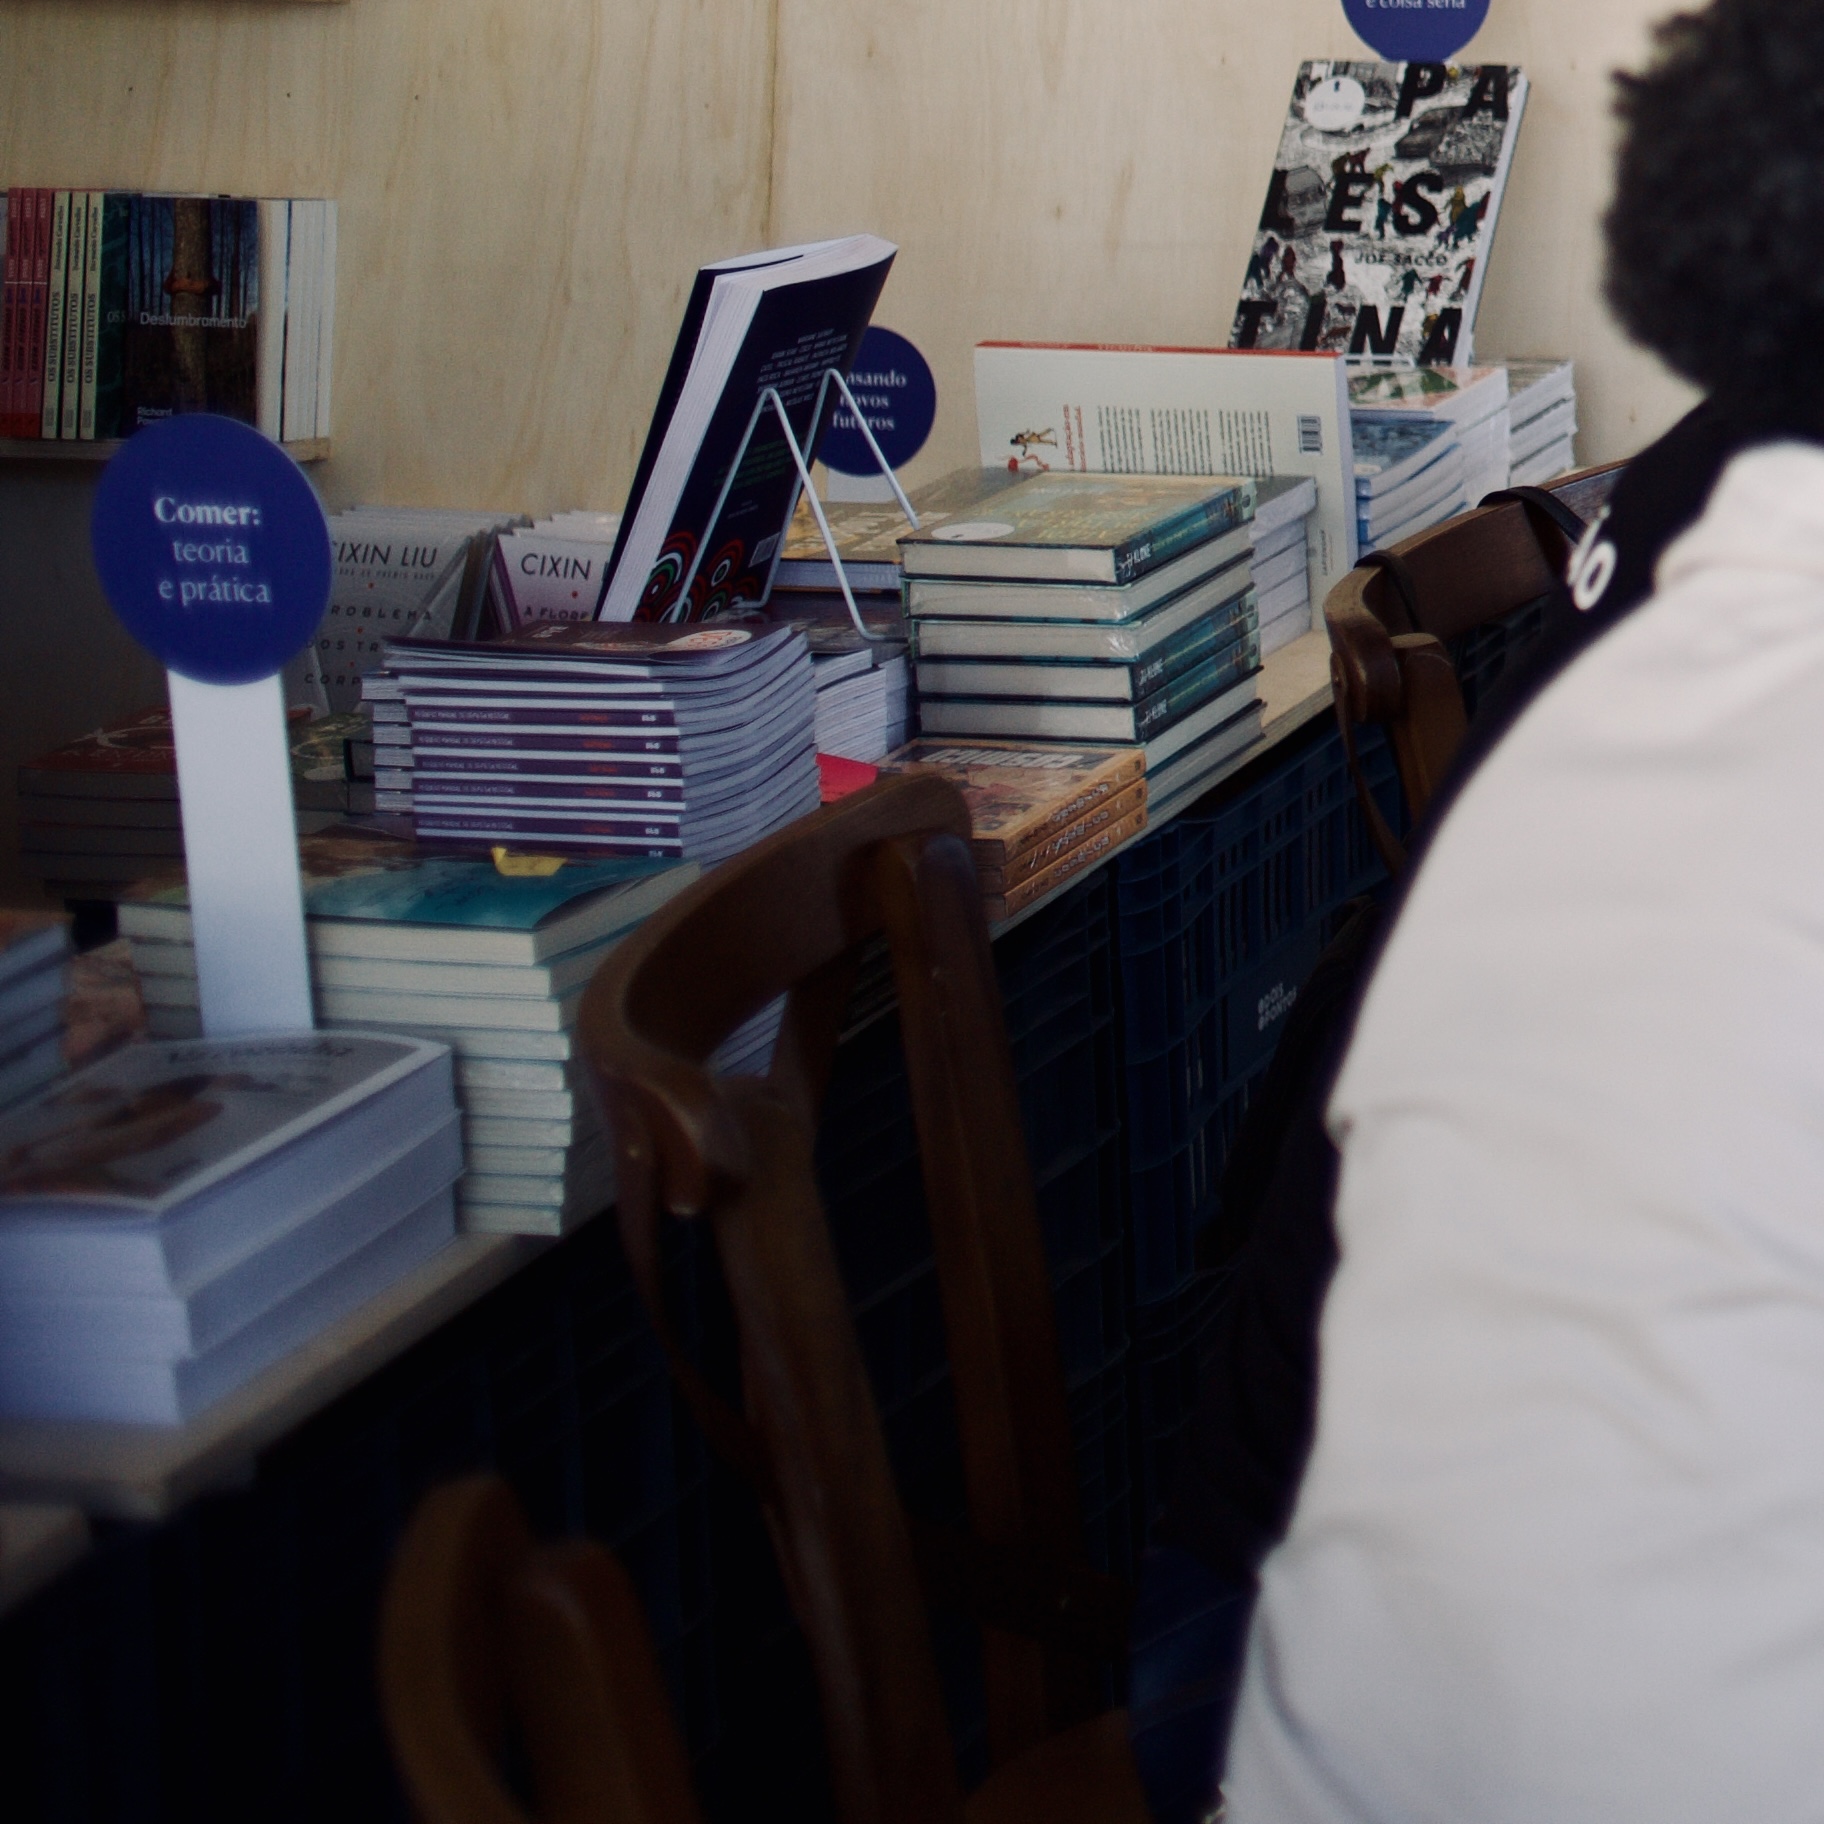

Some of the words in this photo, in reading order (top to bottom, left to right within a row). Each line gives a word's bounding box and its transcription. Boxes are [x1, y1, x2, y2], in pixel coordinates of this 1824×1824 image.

[1395, 61, 1510, 121] PA
[1260, 167, 1445, 236] LES
[49, 291, 61, 363] SUBSTITUTOS
[68, 292, 79, 365] SUBSTITUTOS
[85, 292, 96, 365] SUBSTITUTOS
[1228, 300, 1463, 366] TINA
[154, 495, 261, 527] Comer:
[173, 539, 250, 565] teoria
[401, 546, 437, 568] LIU
[521, 552, 591, 579] CIXIN
[159, 580, 173, 601] e
[181, 573, 272, 607] prática
[524, 606, 533, 617] A
